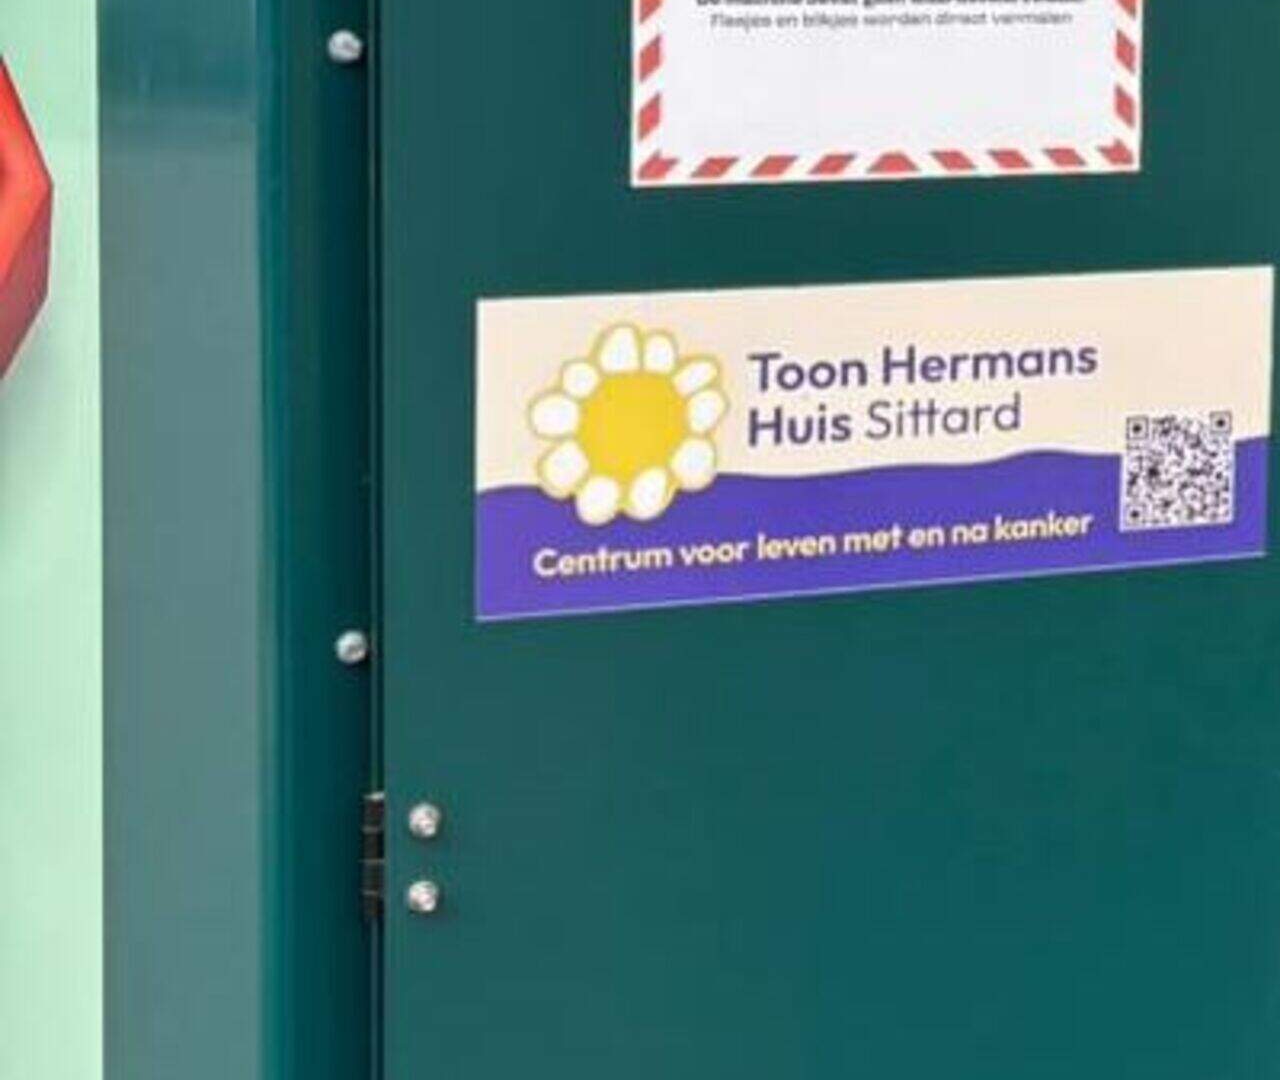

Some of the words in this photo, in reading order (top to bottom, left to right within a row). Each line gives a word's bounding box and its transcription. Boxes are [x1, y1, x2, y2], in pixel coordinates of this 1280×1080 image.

[747, 352, 868, 393] Toon
[882, 344, 1098, 385] Hermans
[748, 402, 852, 448] Huis
[864, 390, 1021, 440] Sittard
[533, 543, 674, 577] Centrum
[678, 541, 749, 566] voor
[757, 531, 837, 560] leven
[843, 523, 901, 553] met
[907, 526, 945, 549] en
[951, 523, 988, 545] na
[993, 509, 1095, 542] kanker
